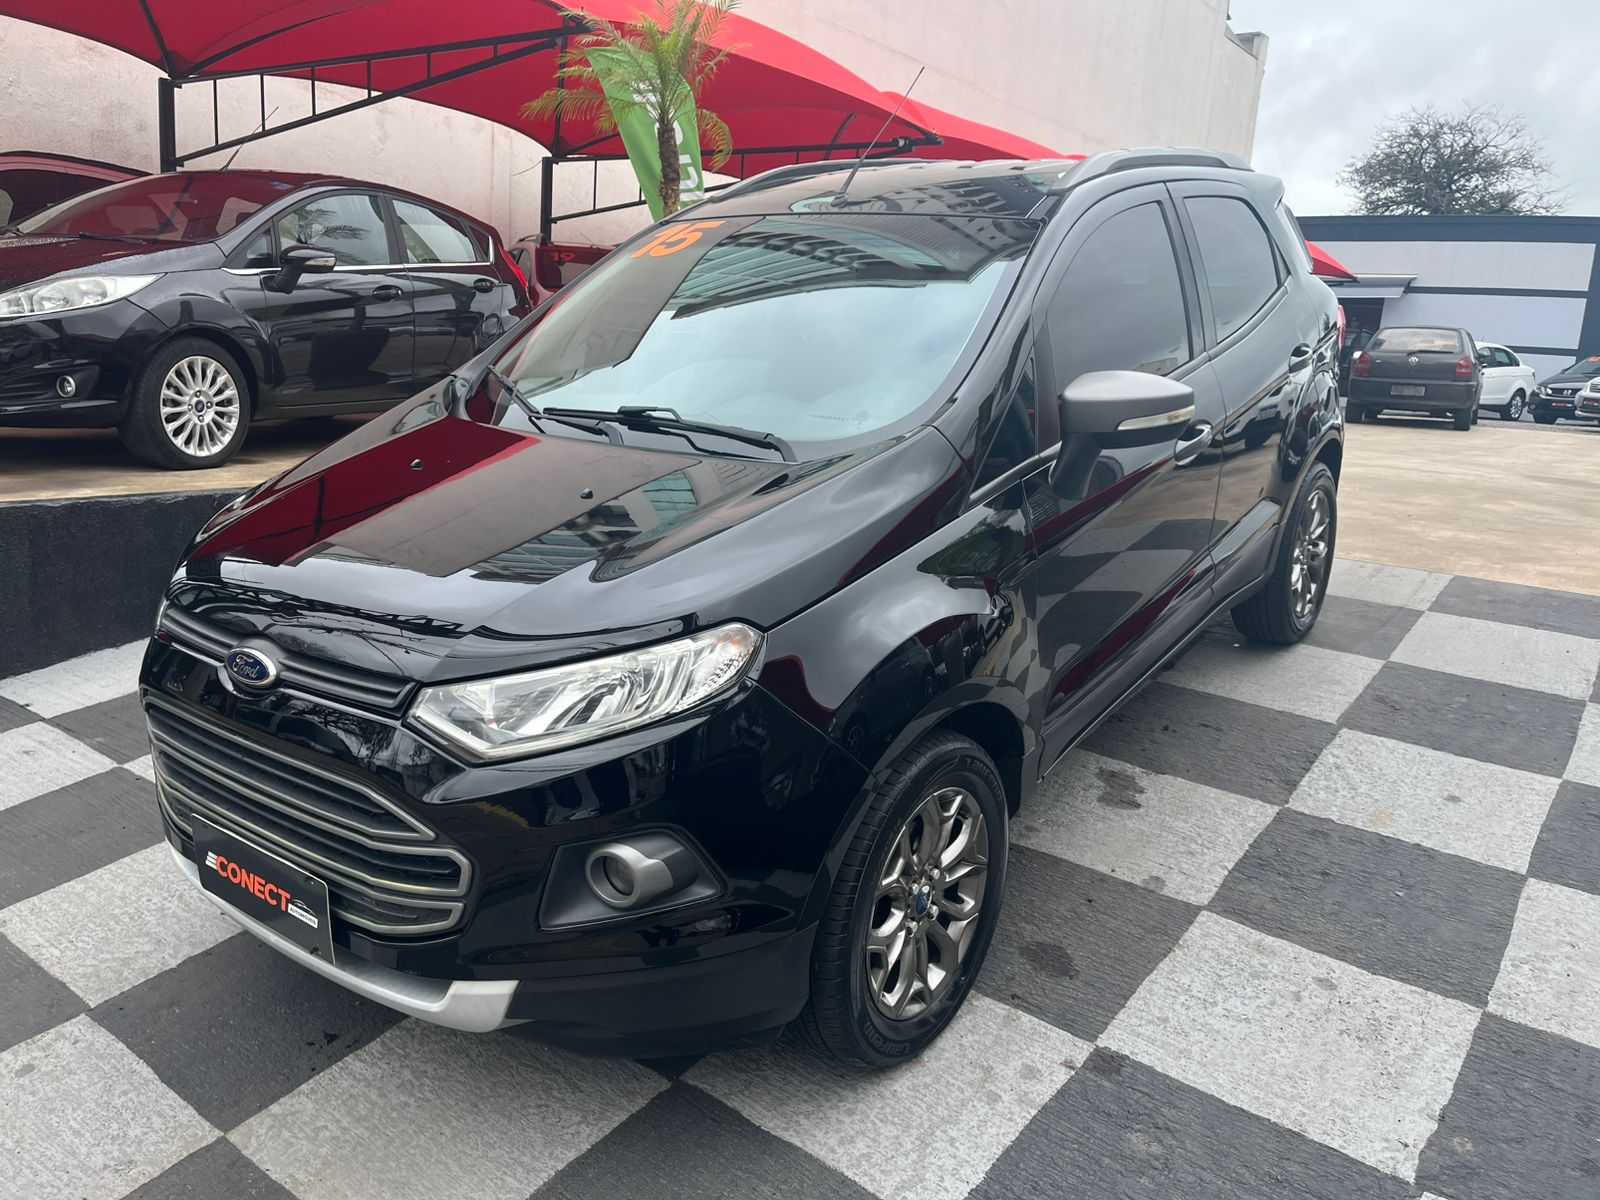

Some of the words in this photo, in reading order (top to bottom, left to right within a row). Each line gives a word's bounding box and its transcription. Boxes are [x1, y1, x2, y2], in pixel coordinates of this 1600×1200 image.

[631, 220, 727, 257] 15
[233, 654, 260, 679] Ford
[215, 855, 291, 912] CONECT
